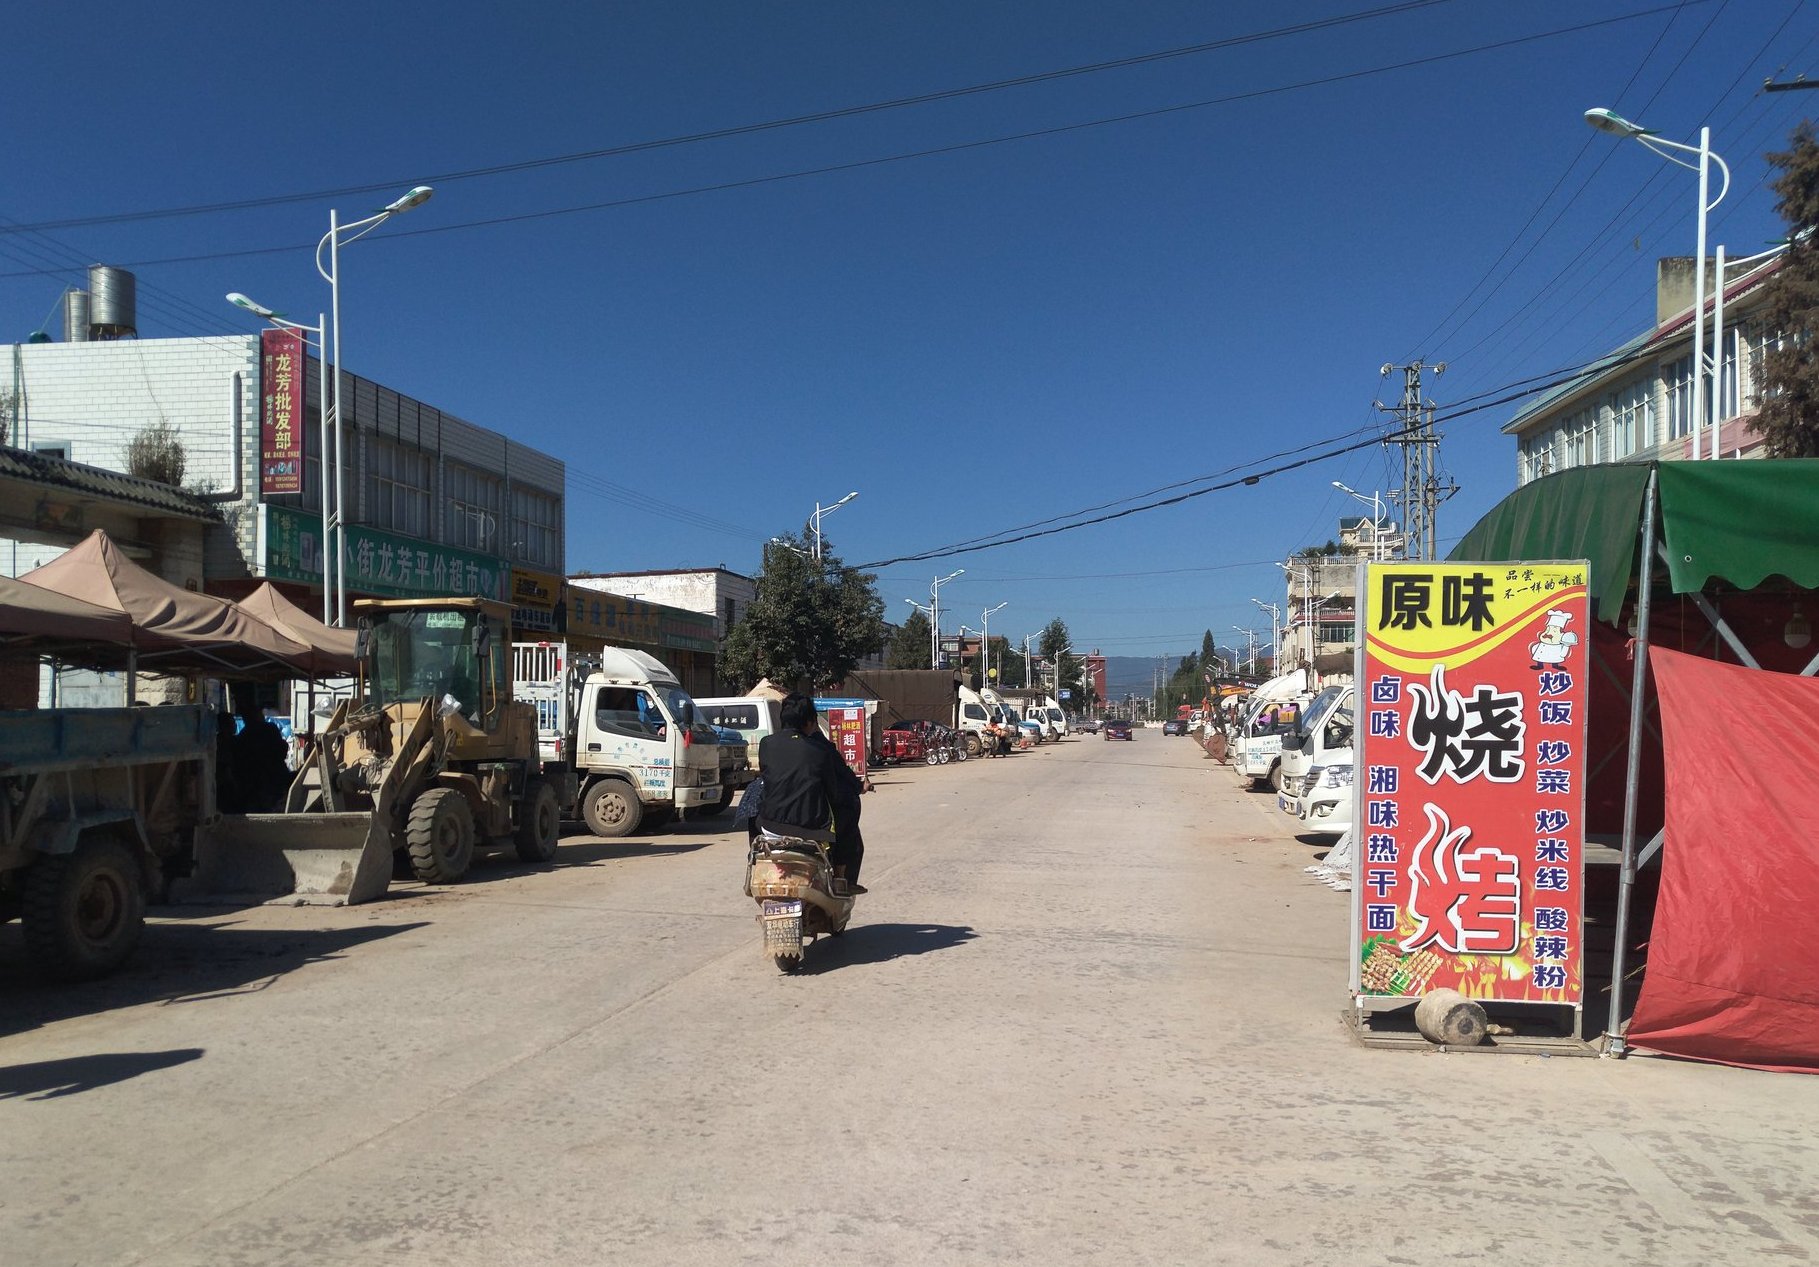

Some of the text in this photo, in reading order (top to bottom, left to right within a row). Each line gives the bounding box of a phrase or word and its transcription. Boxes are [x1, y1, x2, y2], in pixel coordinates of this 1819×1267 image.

[275, 353, 292, 450] 龙芳批发部
[1379, 572, 1495, 631] 原味
[1503, 573, 1584, 600] 不一样的味道
[843, 733, 856, 761] 超市
[1366, 676, 1402, 933] 卤味 湘味热干面
[1533, 671, 1573, 988] 炒饭 炒菜 炒米线 酸辣粉
